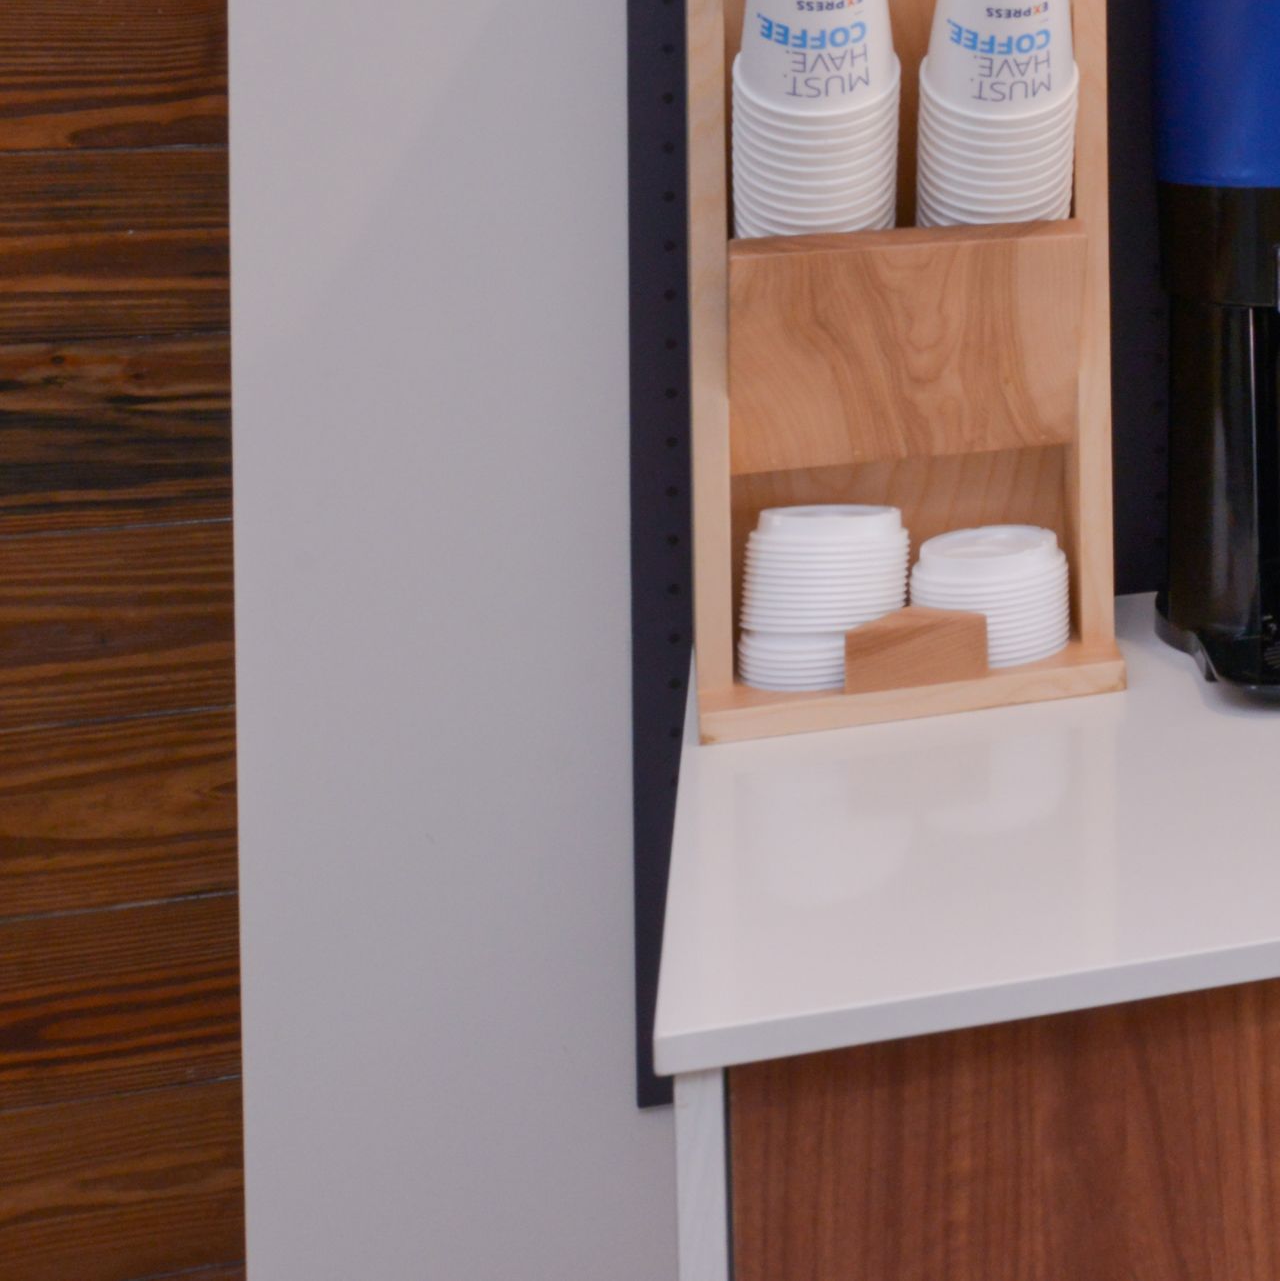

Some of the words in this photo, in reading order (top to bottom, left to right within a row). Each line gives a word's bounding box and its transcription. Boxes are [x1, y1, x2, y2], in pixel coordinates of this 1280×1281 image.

[985, 1, 1049, 18] EXPRESS
[757, 12, 867, 50] COFFEE.
[946, 18, 1051, 55] COFFEE.
[785, 43, 868, 73] HAVE.
[974, 50, 1051, 78] HAVE.
[784, 66, 870, 99] MUST.
[970, 72, 1052, 103] MUST.
